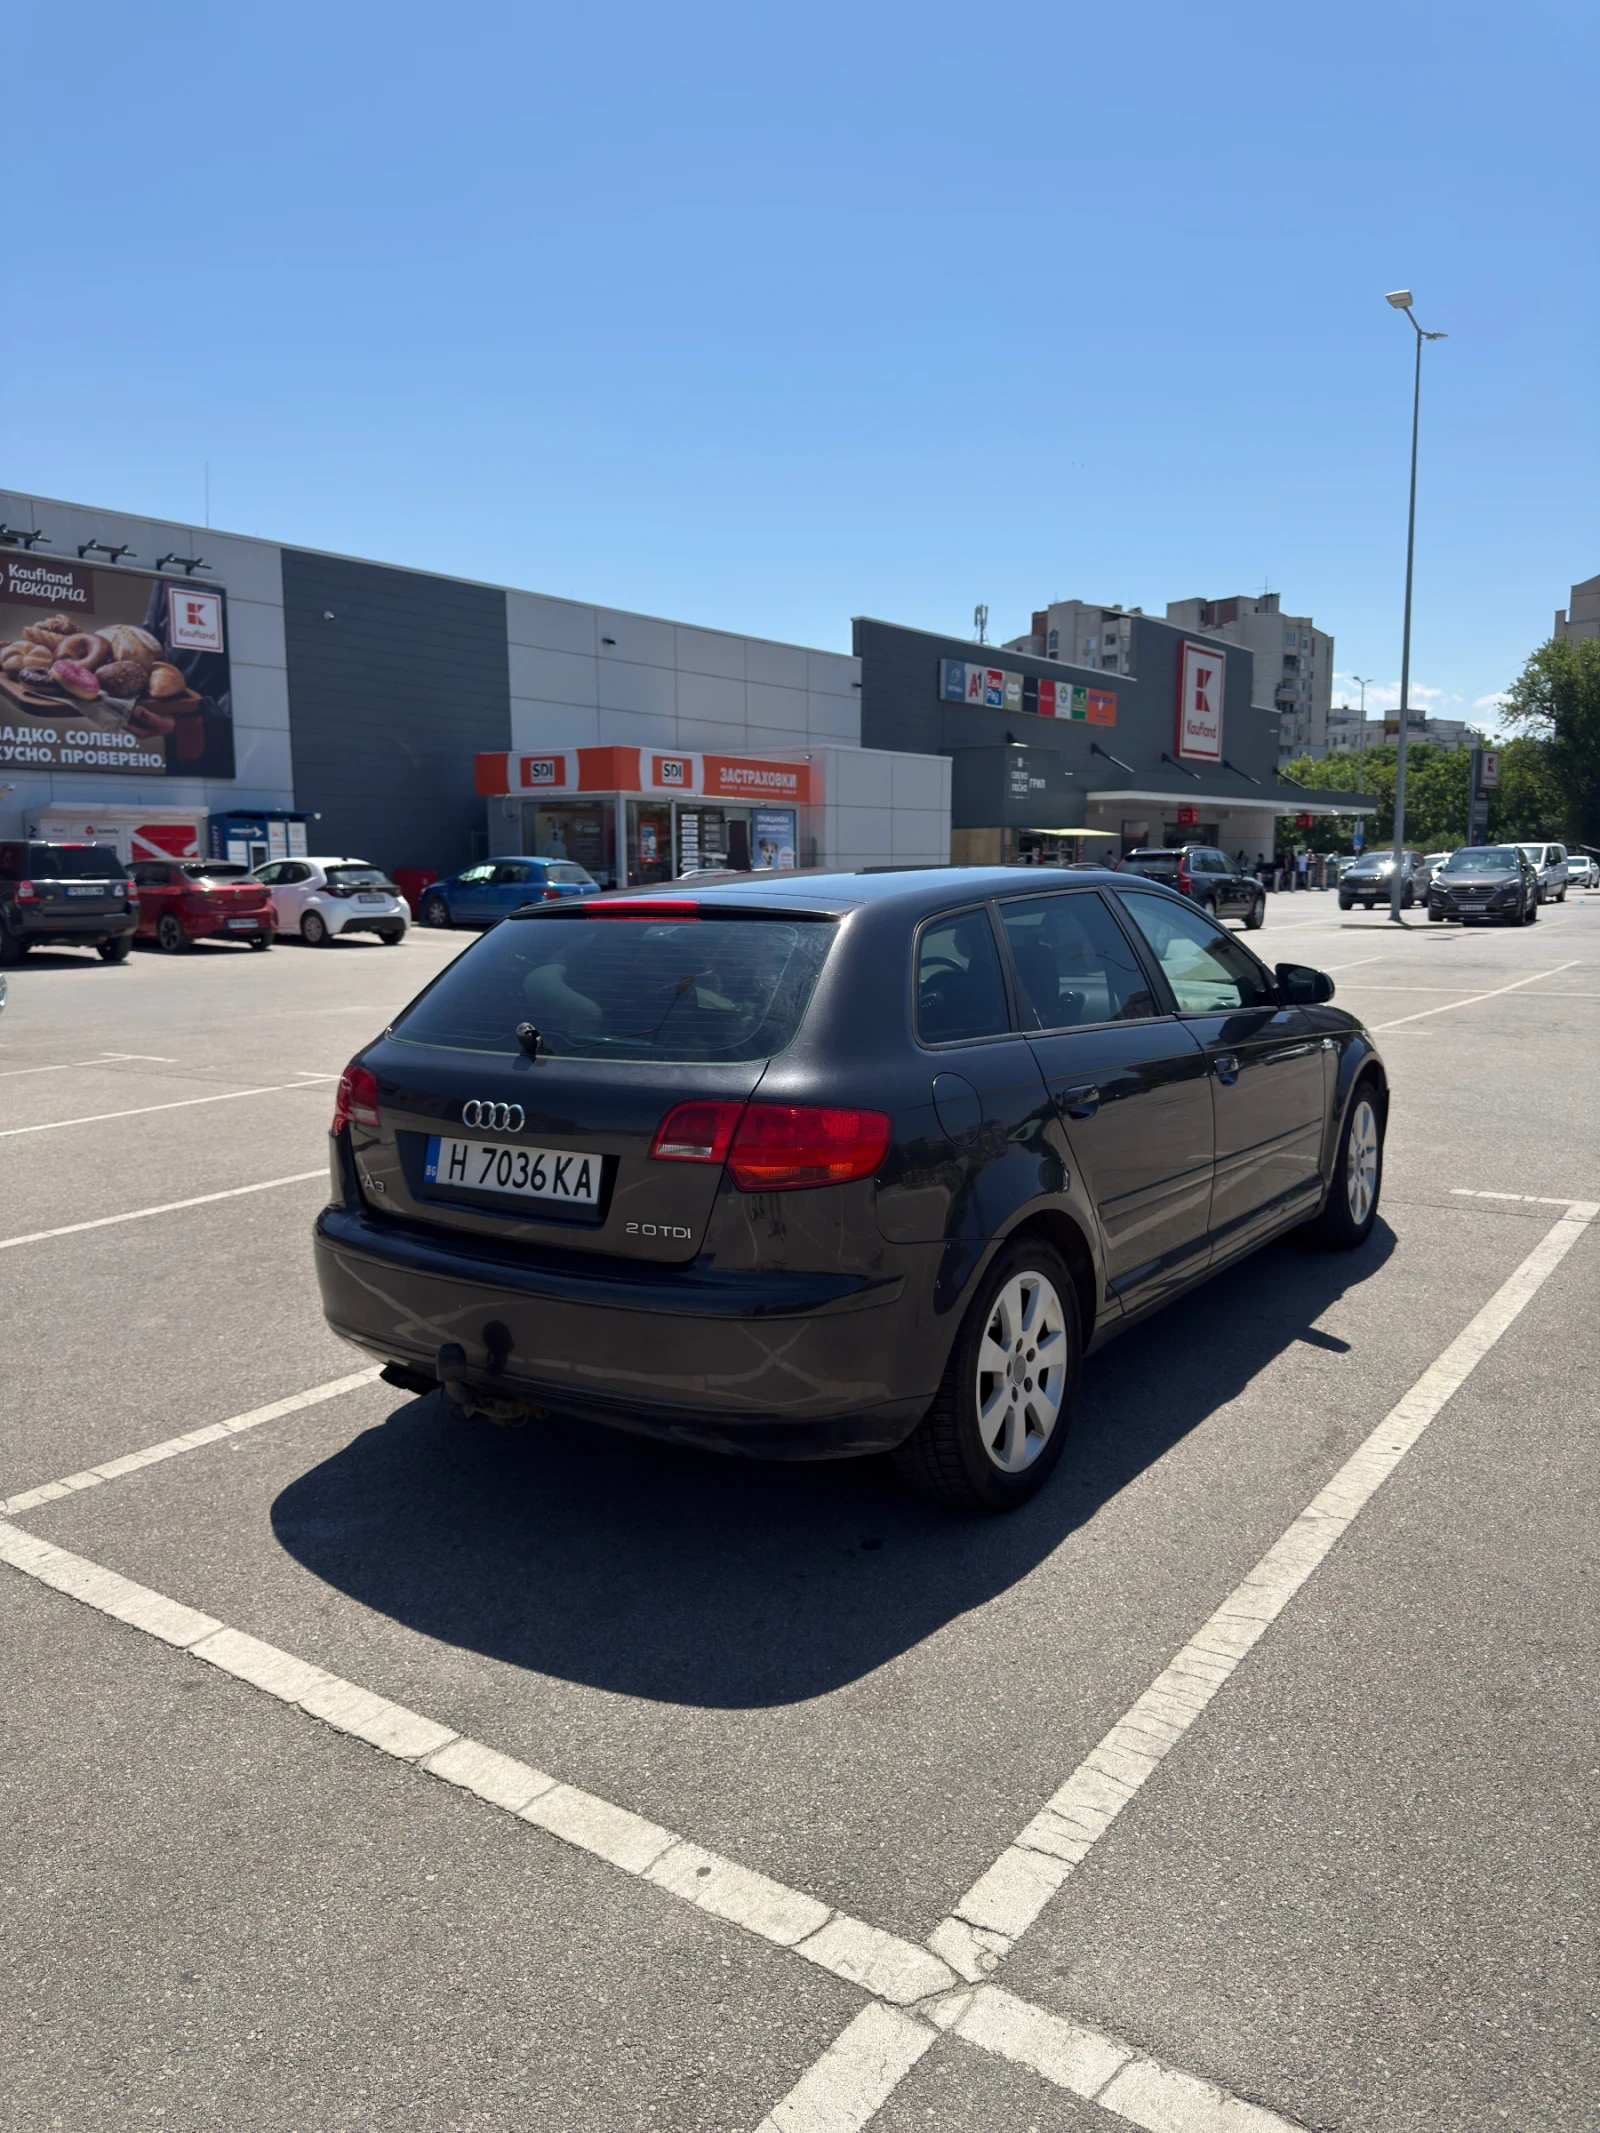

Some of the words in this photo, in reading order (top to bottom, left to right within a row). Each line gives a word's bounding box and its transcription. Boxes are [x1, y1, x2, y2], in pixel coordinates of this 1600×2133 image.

[8, 563, 73, 586] Kaufland
[9, 579, 87, 602] пекарна
[0, 725, 61, 745] АДКО.
[65, 730, 140, 748] СОЛЕНО.
[1187, 720, 1217, 739] Kaufland
[60, 749, 167, 768] ПРОВЕРЕНО.
[533, 762, 553, 777] SDI
[664, 763, 682, 778] SDI
[720, 767, 797, 788] ЗАСТРАХОВКИ
[425, 1165, 437, 1177] BG
[478, 1147, 547, 1192] 7036
[364, 1174, 387, 1193] A3
